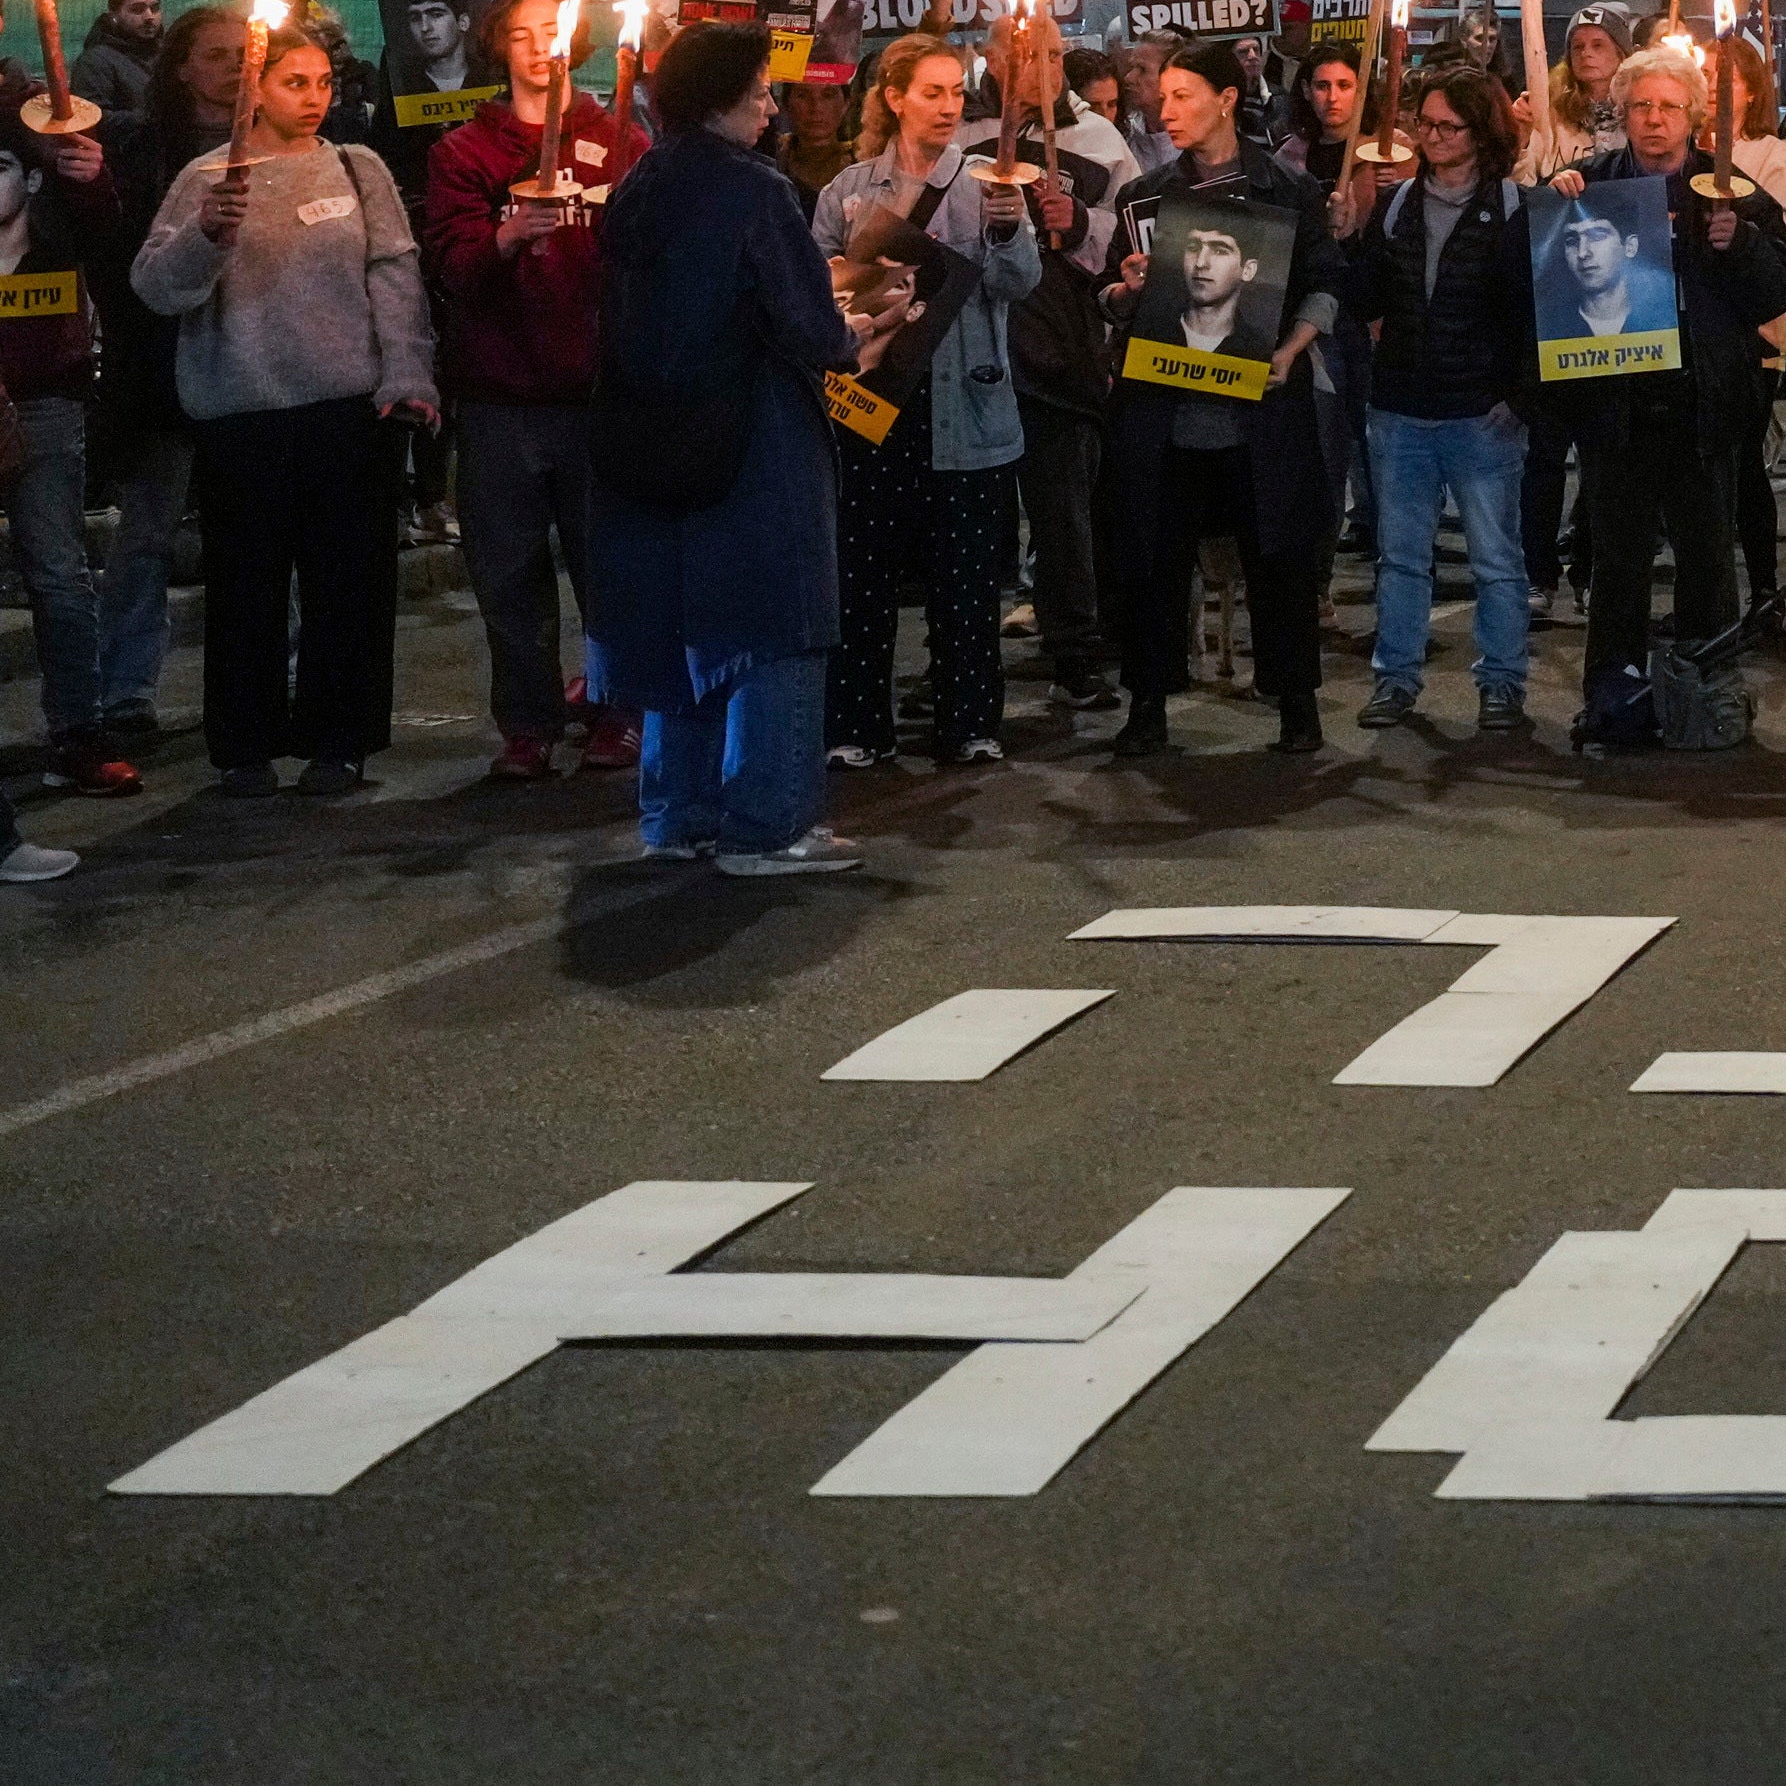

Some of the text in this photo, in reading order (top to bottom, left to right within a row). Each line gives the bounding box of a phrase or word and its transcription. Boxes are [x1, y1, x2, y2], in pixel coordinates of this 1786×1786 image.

[307, 199, 346, 219] 465
[23, 285, 62, 310] עידן
[1557, 344, 1664, 370] איציק אלגרט
[1151, 357, 1243, 387] יוסי שרעבי
